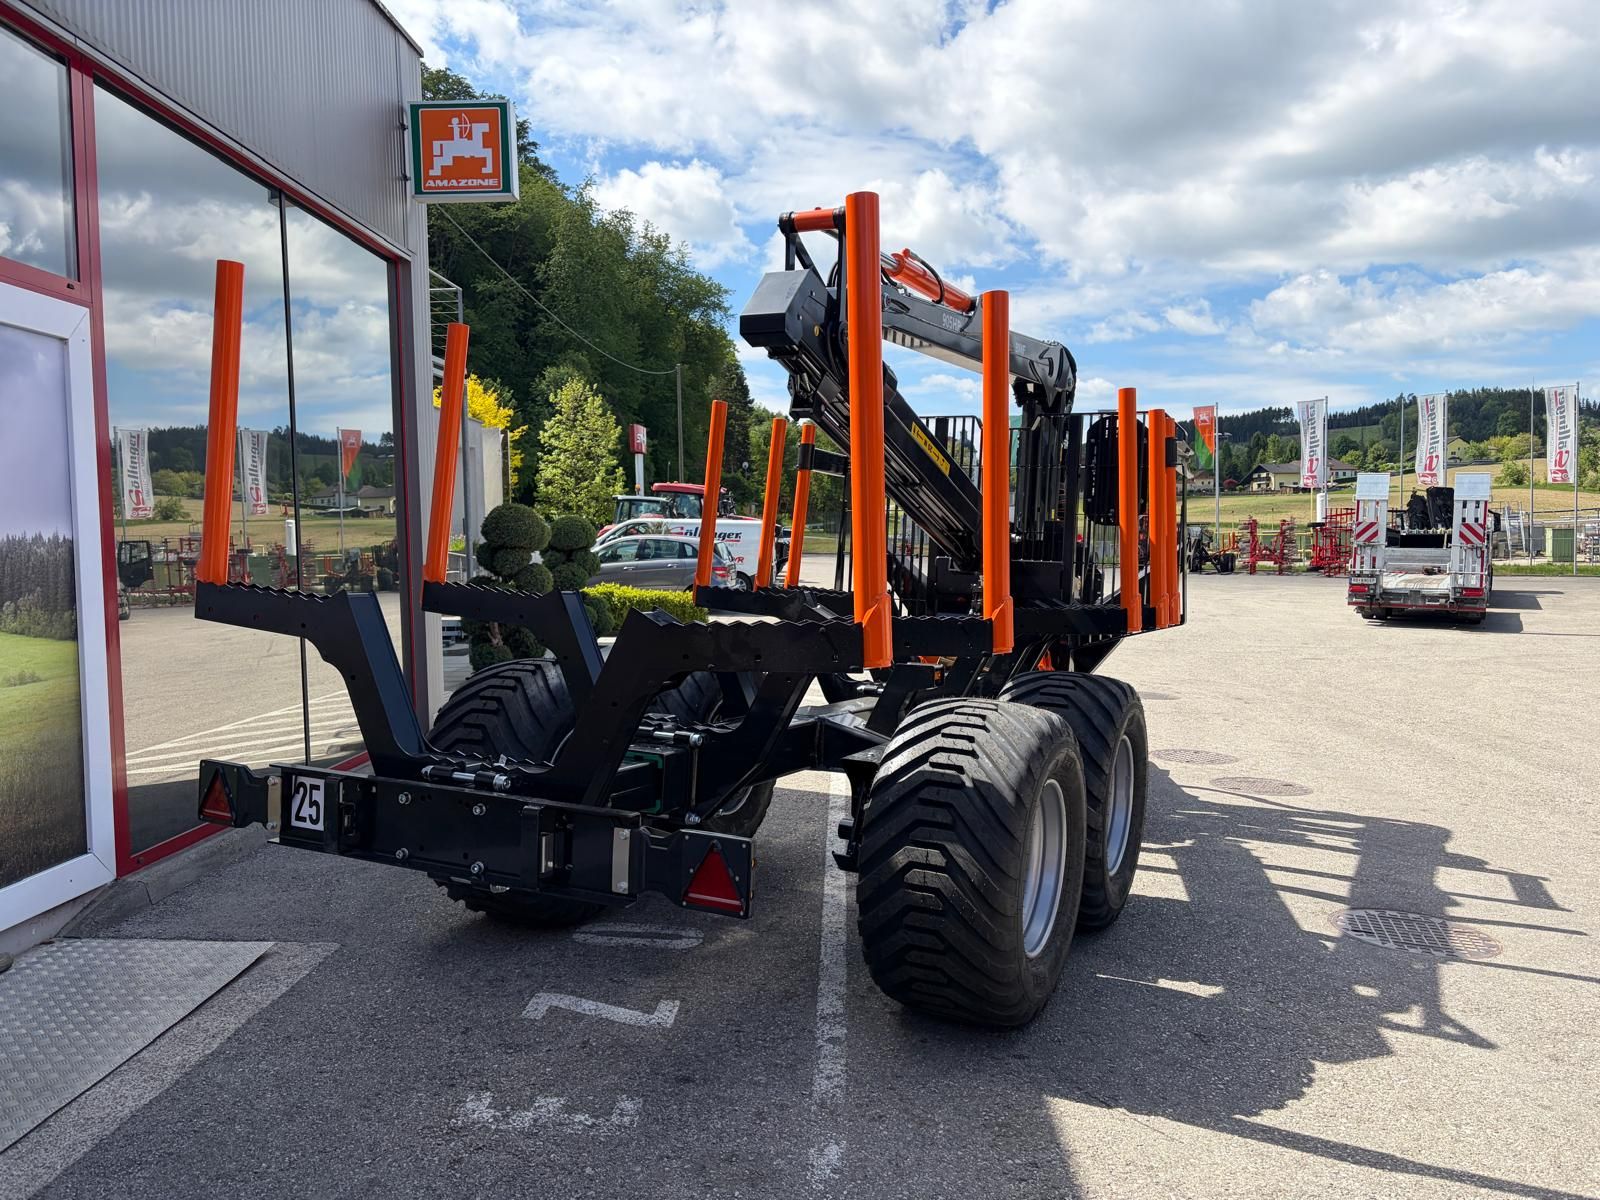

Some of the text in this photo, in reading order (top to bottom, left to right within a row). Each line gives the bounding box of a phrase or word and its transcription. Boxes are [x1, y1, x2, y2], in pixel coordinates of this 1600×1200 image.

[425, 178, 499, 187] AMAZONE
[127, 432, 145, 506] Söllinger
[294, 781, 321, 825] 25
